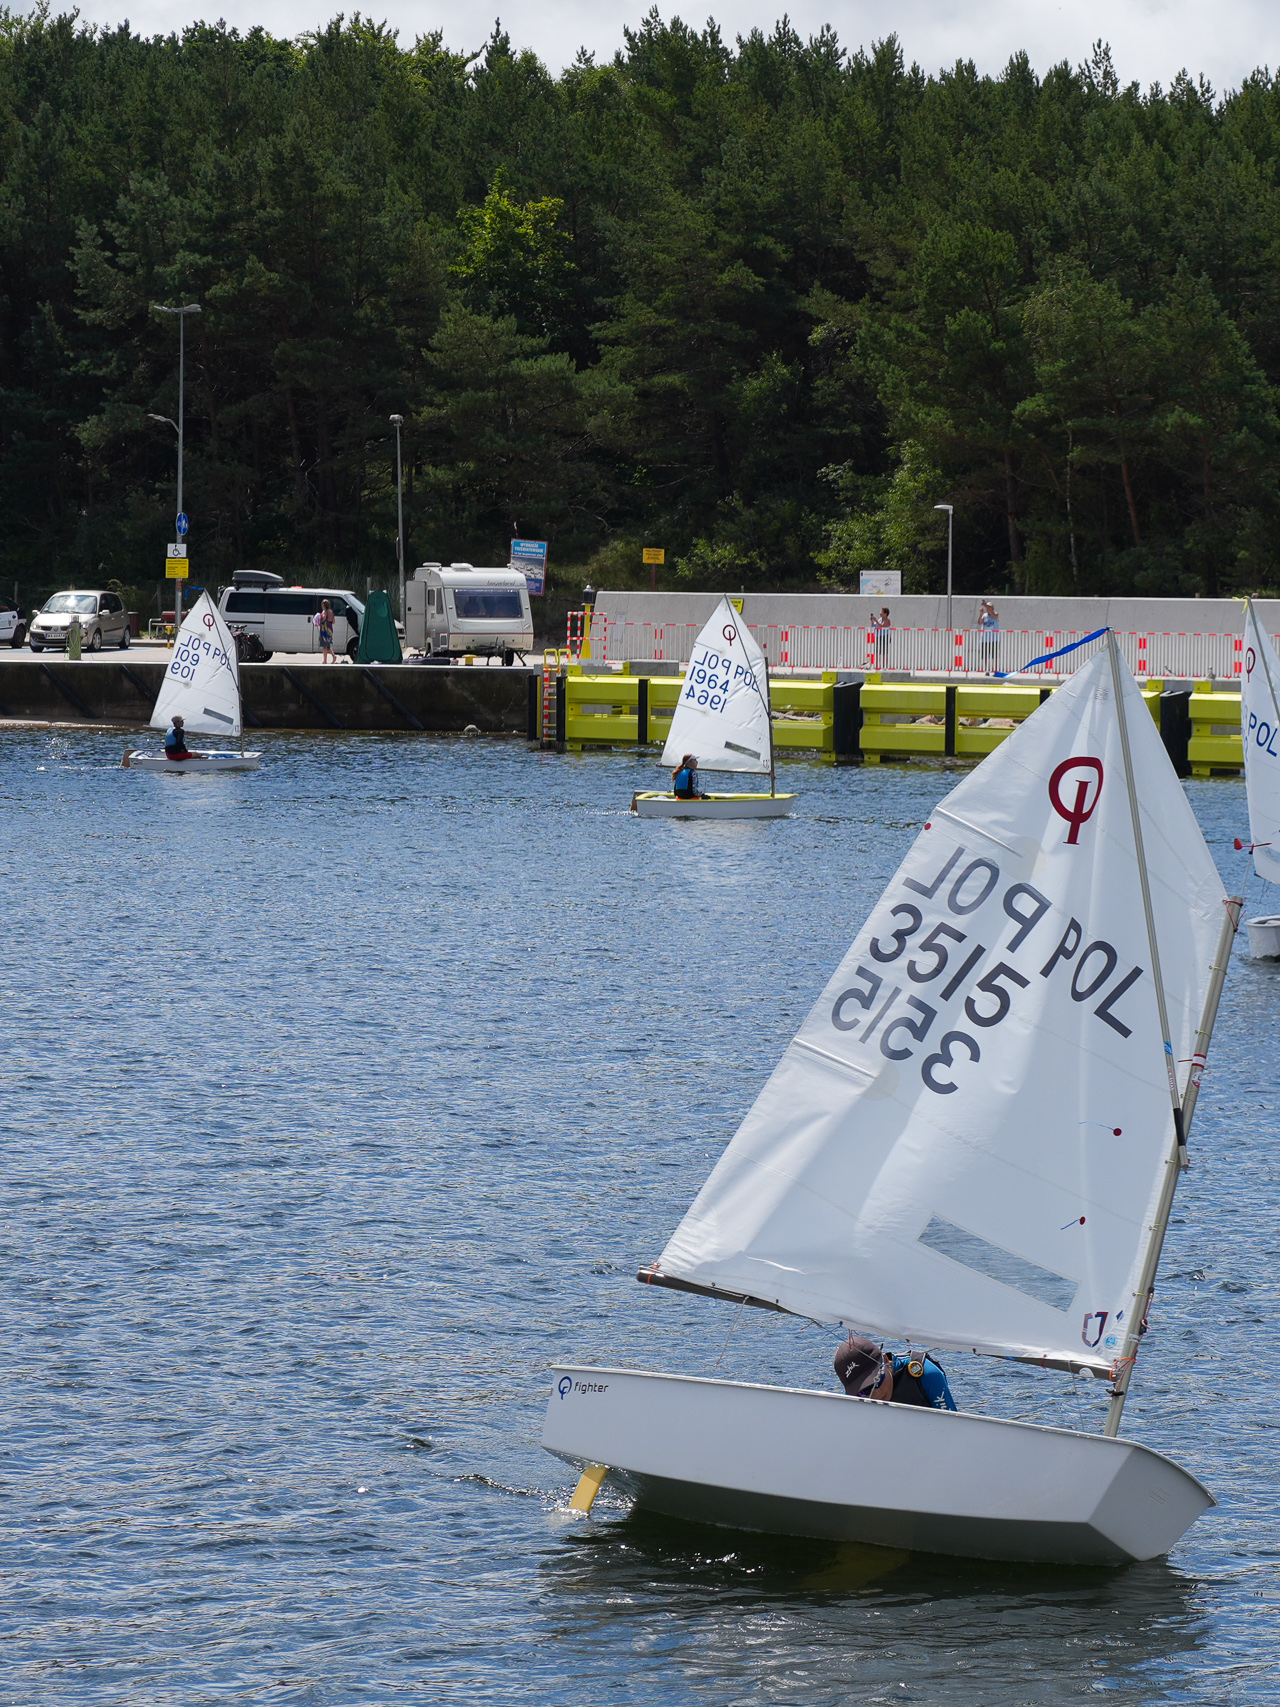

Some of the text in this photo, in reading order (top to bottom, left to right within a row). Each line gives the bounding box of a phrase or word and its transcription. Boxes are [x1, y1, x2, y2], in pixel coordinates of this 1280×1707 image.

[175, 646, 200, 666] 109
[689, 665, 730, 695] 1964
[733, 665, 759, 693] POL
[1248, 711, 1278, 758] POL
[869, 903, 1031, 1028] 3515
[1039, 916, 1144, 1039] POL
[574, 1381, 609, 1395] fighter
